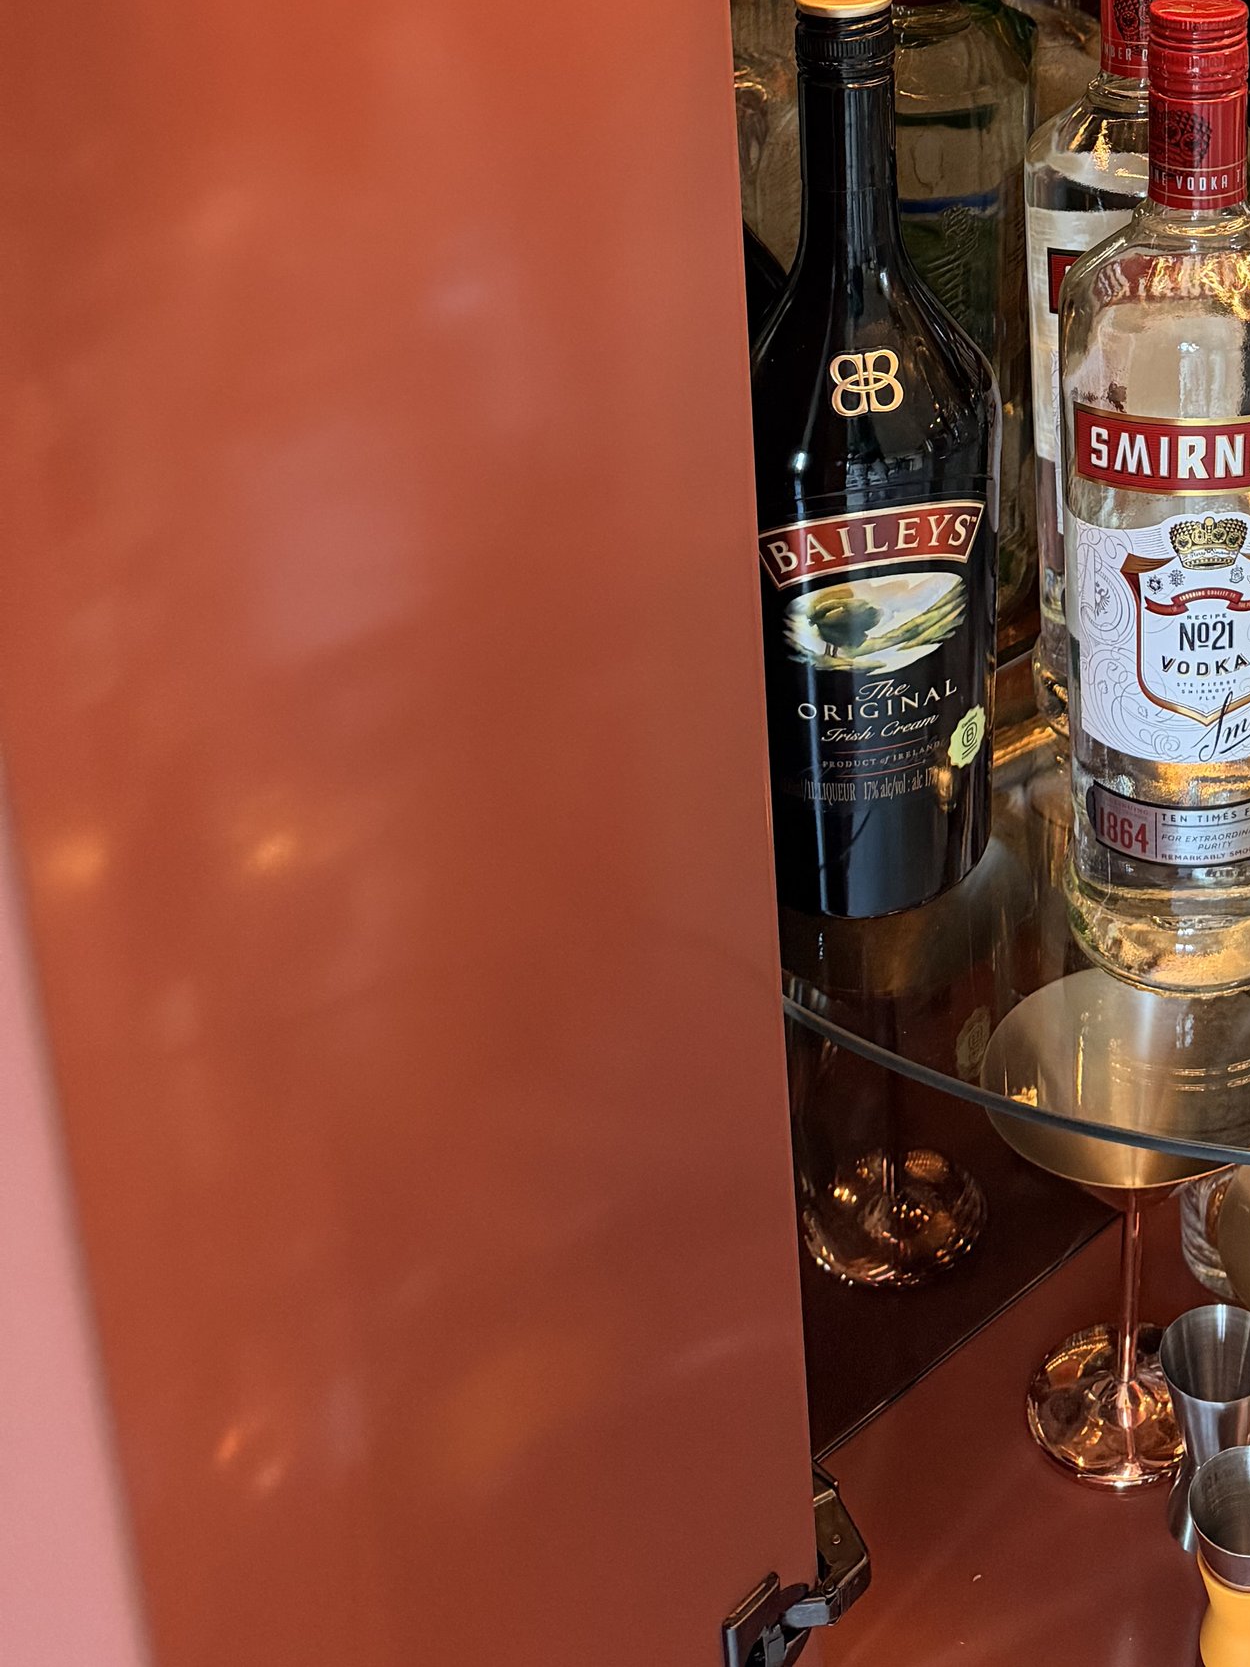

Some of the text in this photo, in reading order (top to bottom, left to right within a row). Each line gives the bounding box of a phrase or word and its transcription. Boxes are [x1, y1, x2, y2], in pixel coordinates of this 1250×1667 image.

[1175, 174, 1228, 191] VODKA
[767, 512, 971, 575] BAILEYS
[1186, 612, 1227, 621] RECIPE
[1161, 652, 1250, 676] VODKA
[797, 678, 958, 721] ORIGINAL
[855, 678, 911, 702] The
[821, 725, 875, 742] Irish
[880, 713, 940, 738] Cream
[822, 741, 941, 768] PRODUCT of IRELAND
[819, 781, 857, 806] LIQUEUR
[863, 778, 881, 802] 17%
[1161, 812, 1188, 823] TEN
[1196, 809, 1238, 824] TIMES
[1100, 806, 1150, 854] 1864
[1161, 834, 1183, 843] FOR
[1161, 852, 1227, 861] REMARKABLY
[1197, 840, 1234, 851] PURITY
